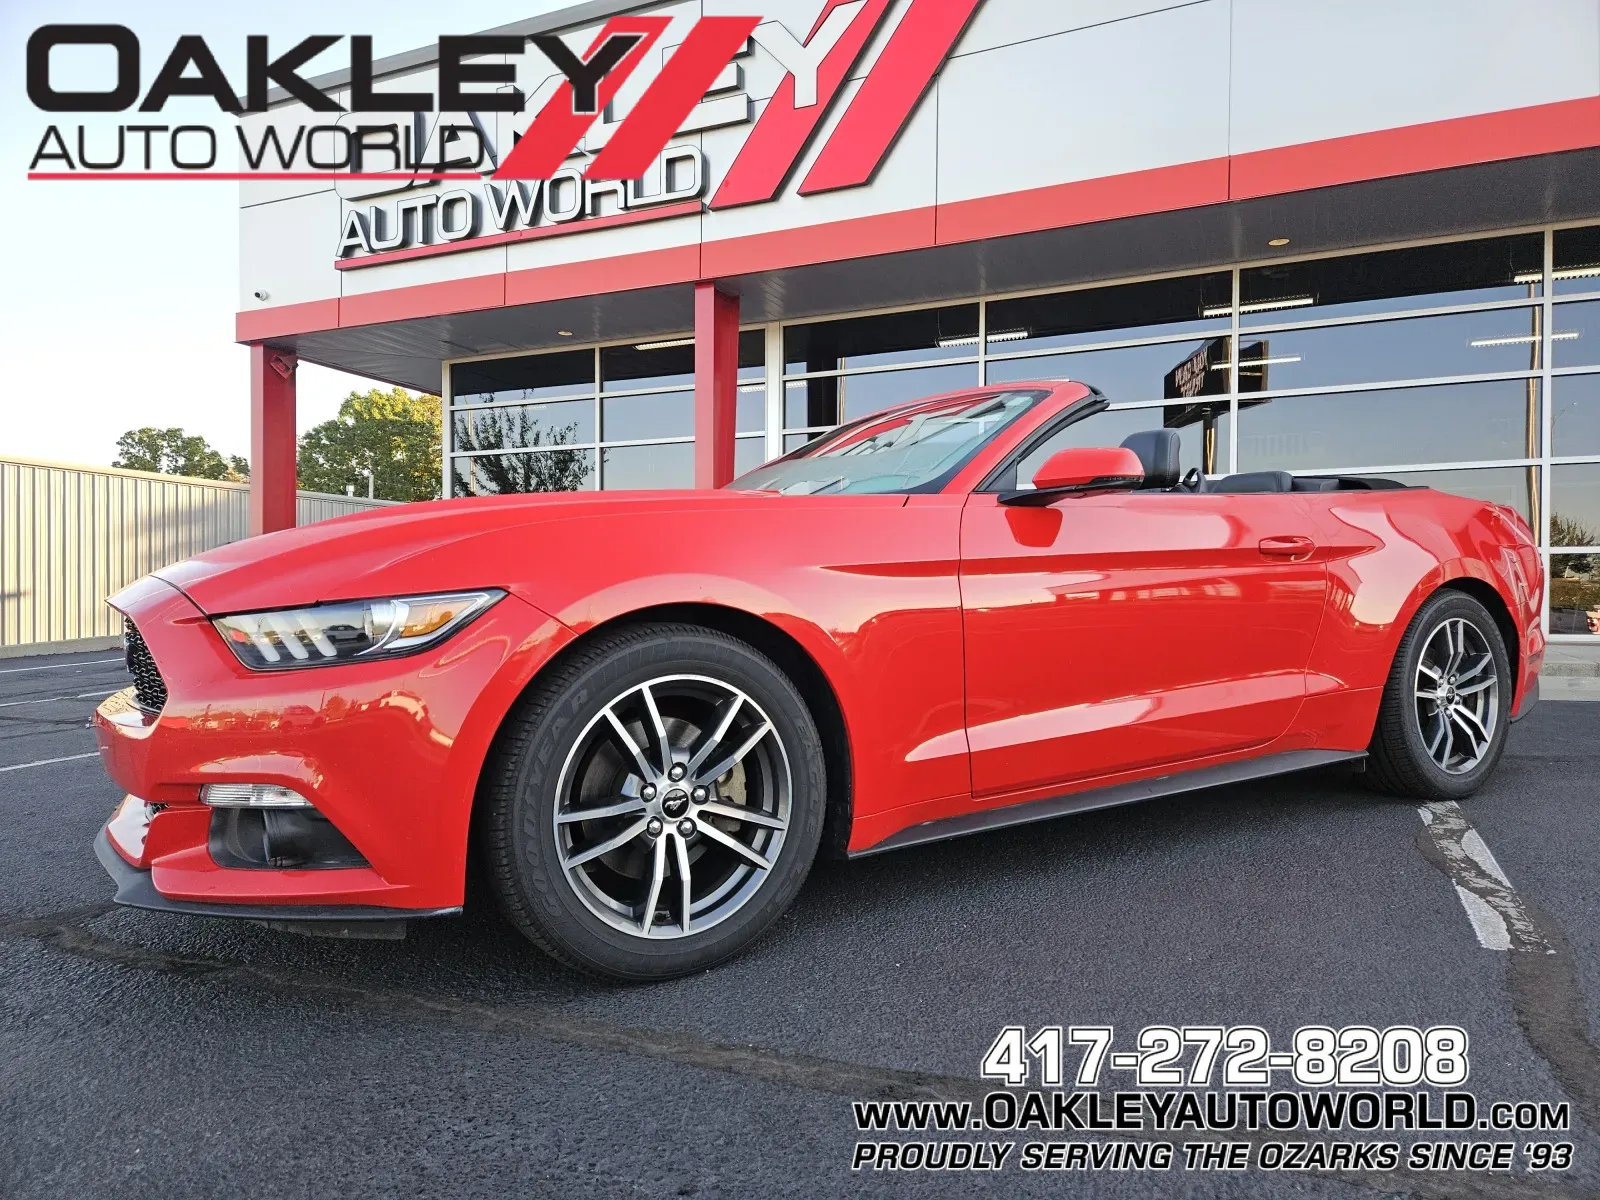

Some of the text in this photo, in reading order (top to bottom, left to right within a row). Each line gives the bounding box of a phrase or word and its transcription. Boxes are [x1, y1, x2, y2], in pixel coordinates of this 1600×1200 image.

[335, 145, 708, 257] AUTO WORLD
[523, 689, 590, 919] GOODYEAR
